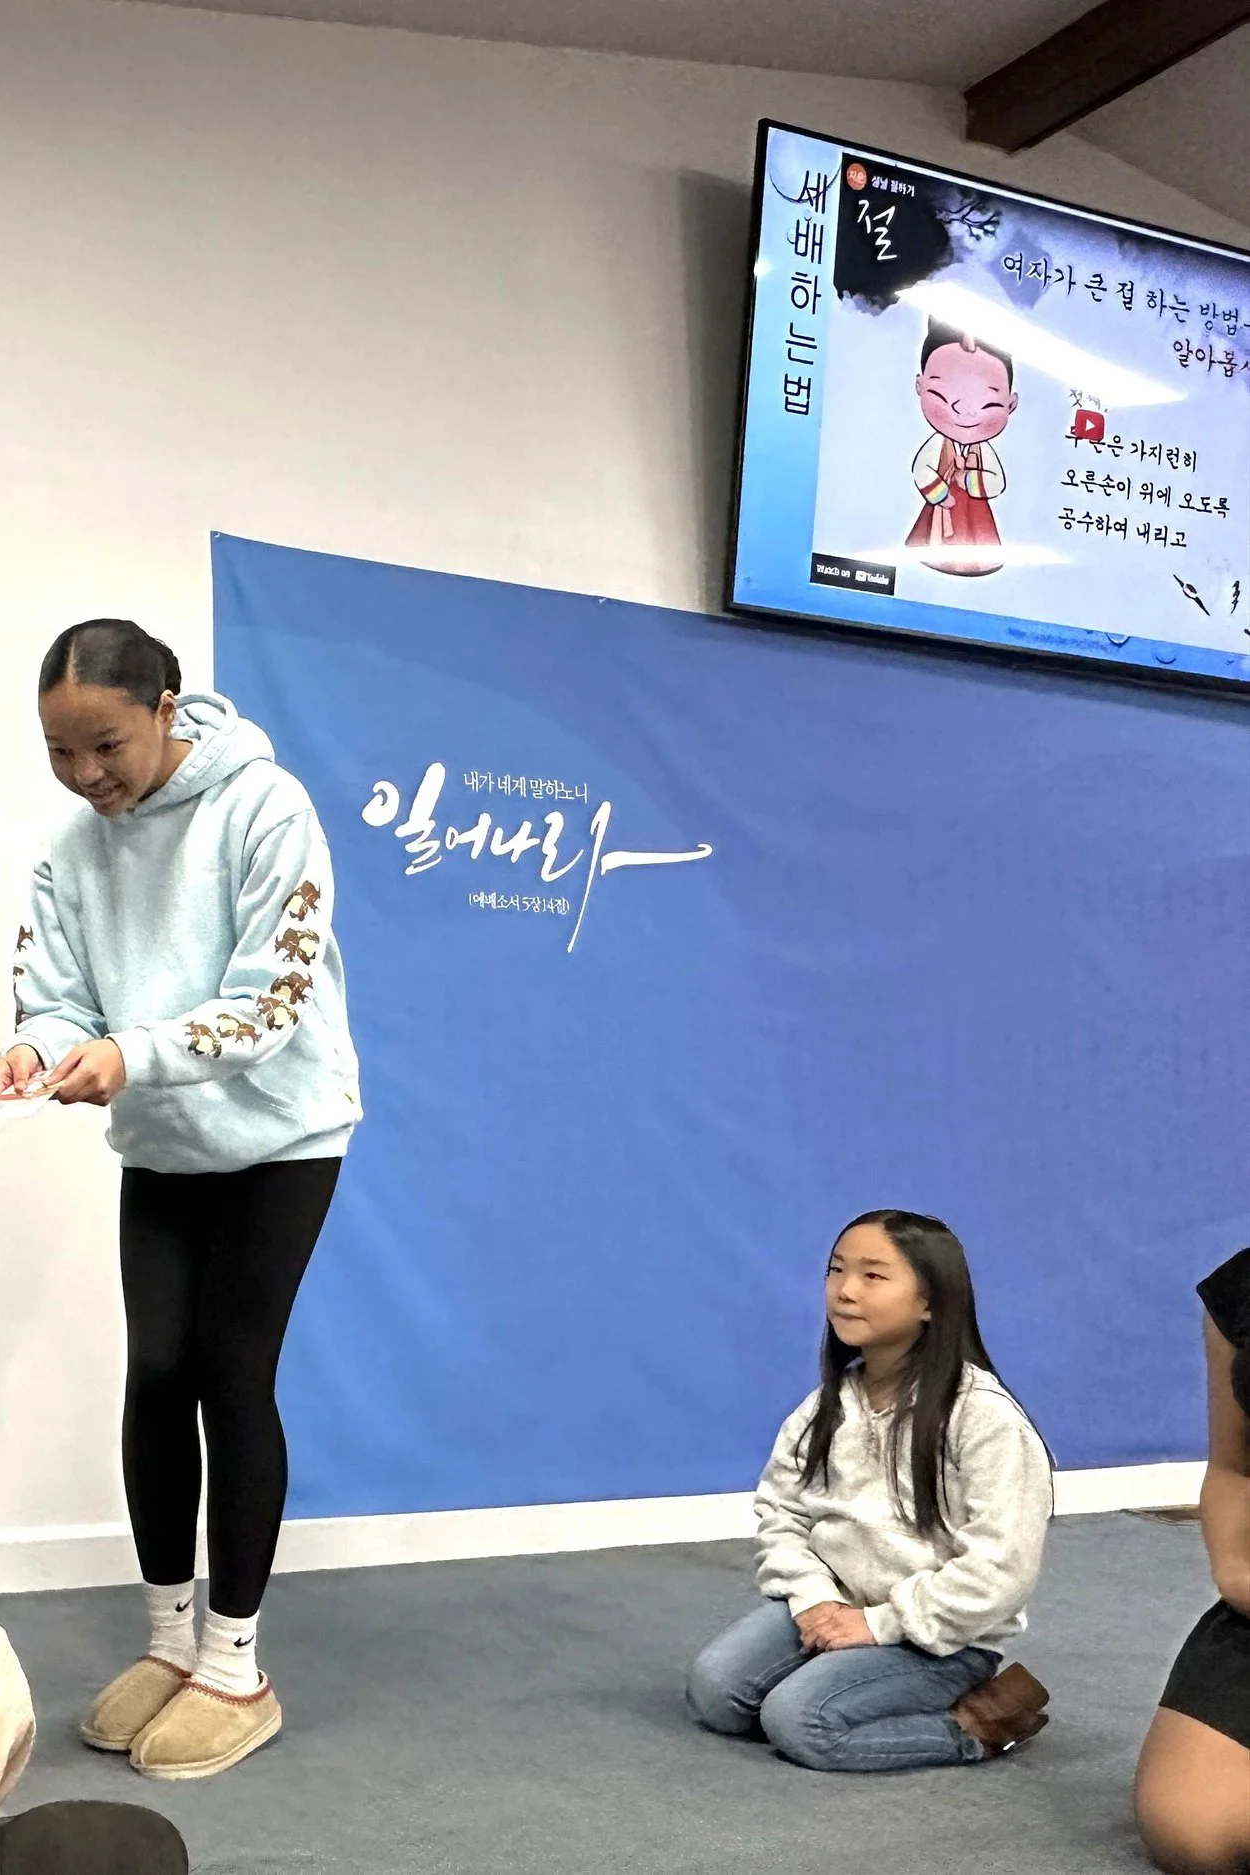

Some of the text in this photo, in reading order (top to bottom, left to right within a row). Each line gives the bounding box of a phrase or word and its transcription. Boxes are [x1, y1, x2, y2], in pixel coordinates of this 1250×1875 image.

[857, 199, 898, 261] 절
[1003, 252, 1250, 336] 여자가 큰 절 하는 방법
[1130, 439, 1197, 473] 가지런히
[1060, 469, 1230, 518] 오른손이 위에 오도록
[1058, 507, 1187, 548] 공수하여 내리고
[463, 770, 588, 804] 내가 네게 말하노니
[361, 761, 714, 954] 일어나라
